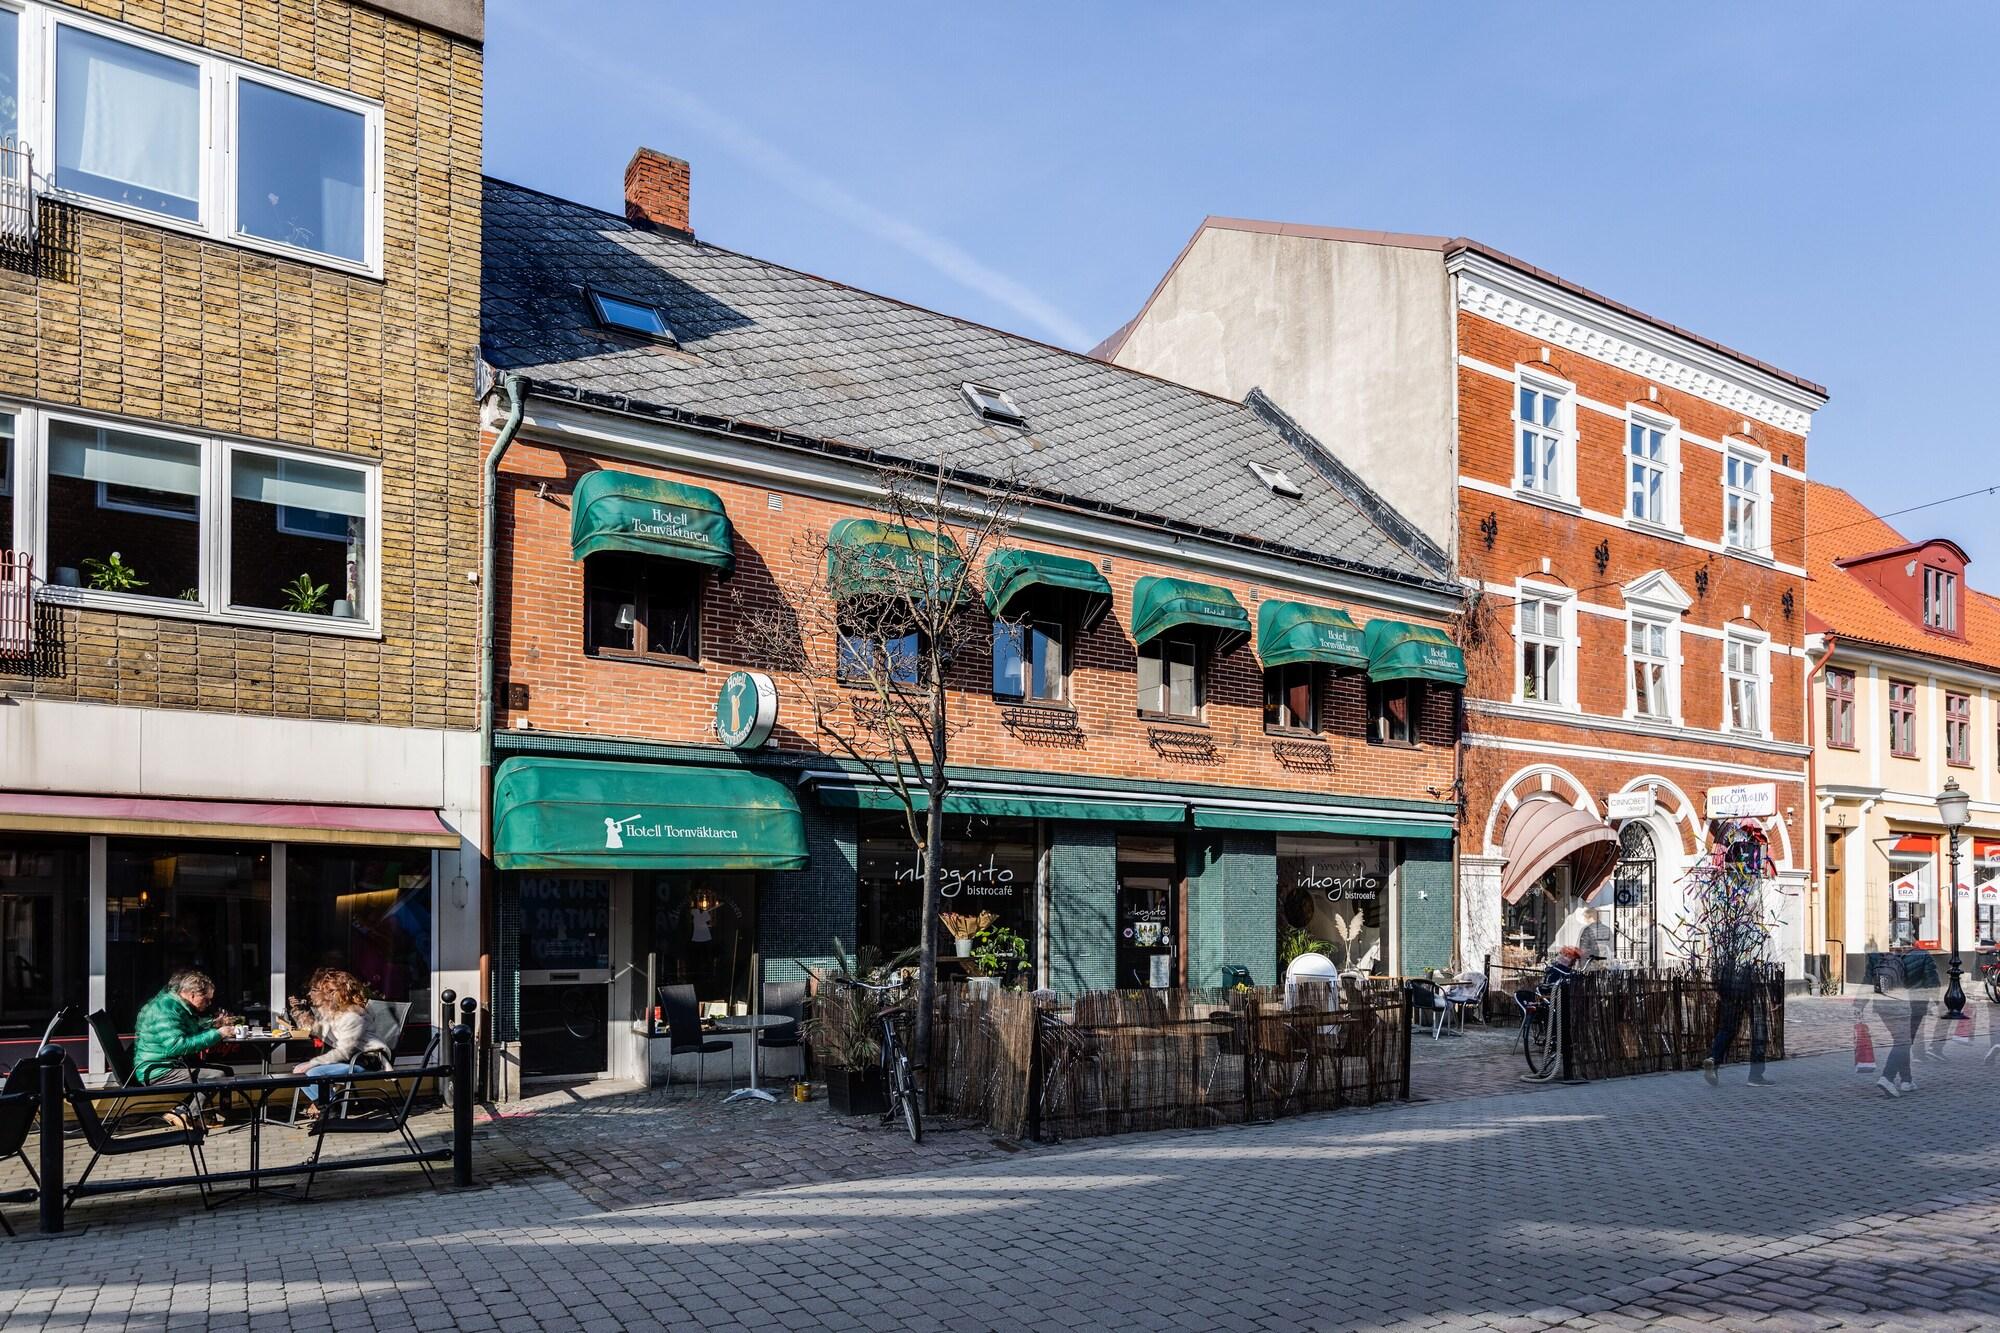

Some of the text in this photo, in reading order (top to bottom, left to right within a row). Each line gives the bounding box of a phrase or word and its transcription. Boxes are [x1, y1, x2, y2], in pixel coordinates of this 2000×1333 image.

[652, 508, 688, 526] Hotell
[631, 517, 709, 543] Tornväktaren
[1327, 629, 1348, 641] Hotell
[1319, 637, 1360, 653] Tornväktaren
[1430, 647, 1448, 659] Hotell
[727, 672, 747, 692] Hotell
[1838, 813, 1847, 827] 37
[626, 824, 738, 839] Hotell Tornväktaren
[967, 885, 1013, 896] bistrocafé
[1297, 865, 1377, 902] inkognito
[1344, 891, 1376, 900] bistrocafé
